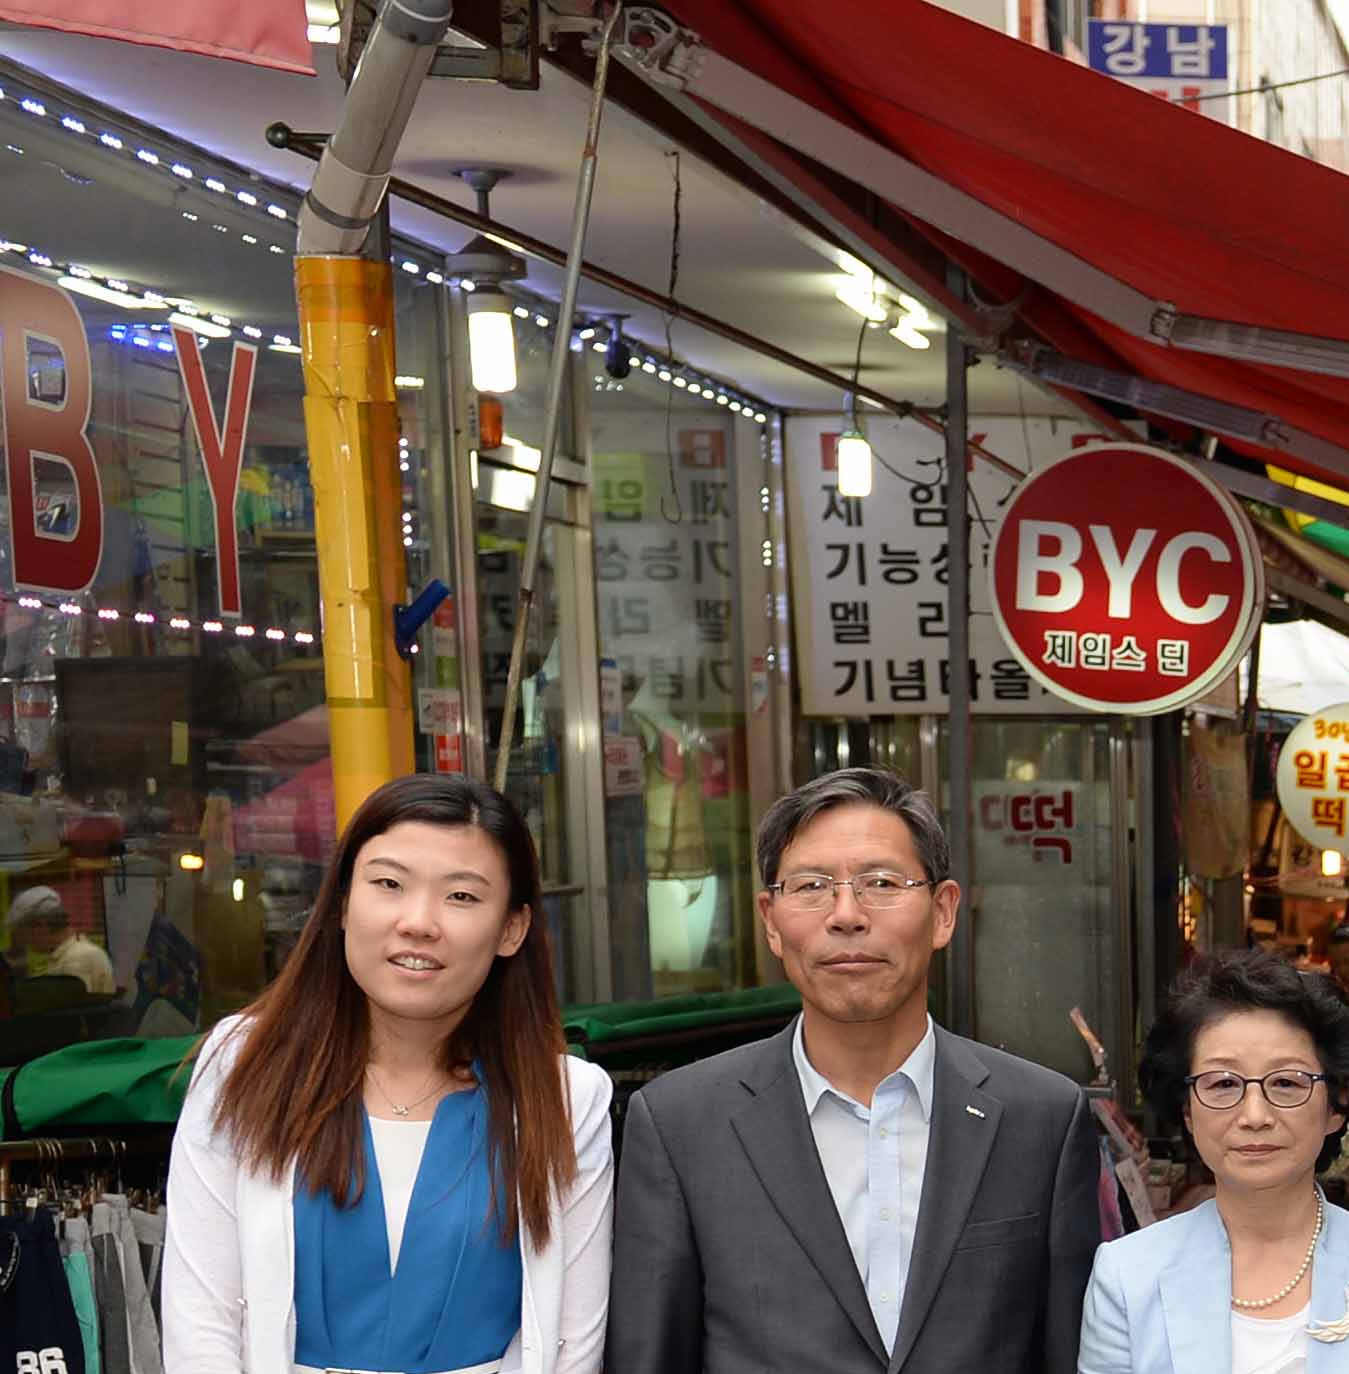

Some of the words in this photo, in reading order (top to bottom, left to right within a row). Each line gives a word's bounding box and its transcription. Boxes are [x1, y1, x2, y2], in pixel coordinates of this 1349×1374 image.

[1103, 25, 1216, 77] 강남
[1015, 519, 1232, 625] BYC
[1043, 630, 1146, 671] 제임스
[1157, 638, 1189, 677] 딘
